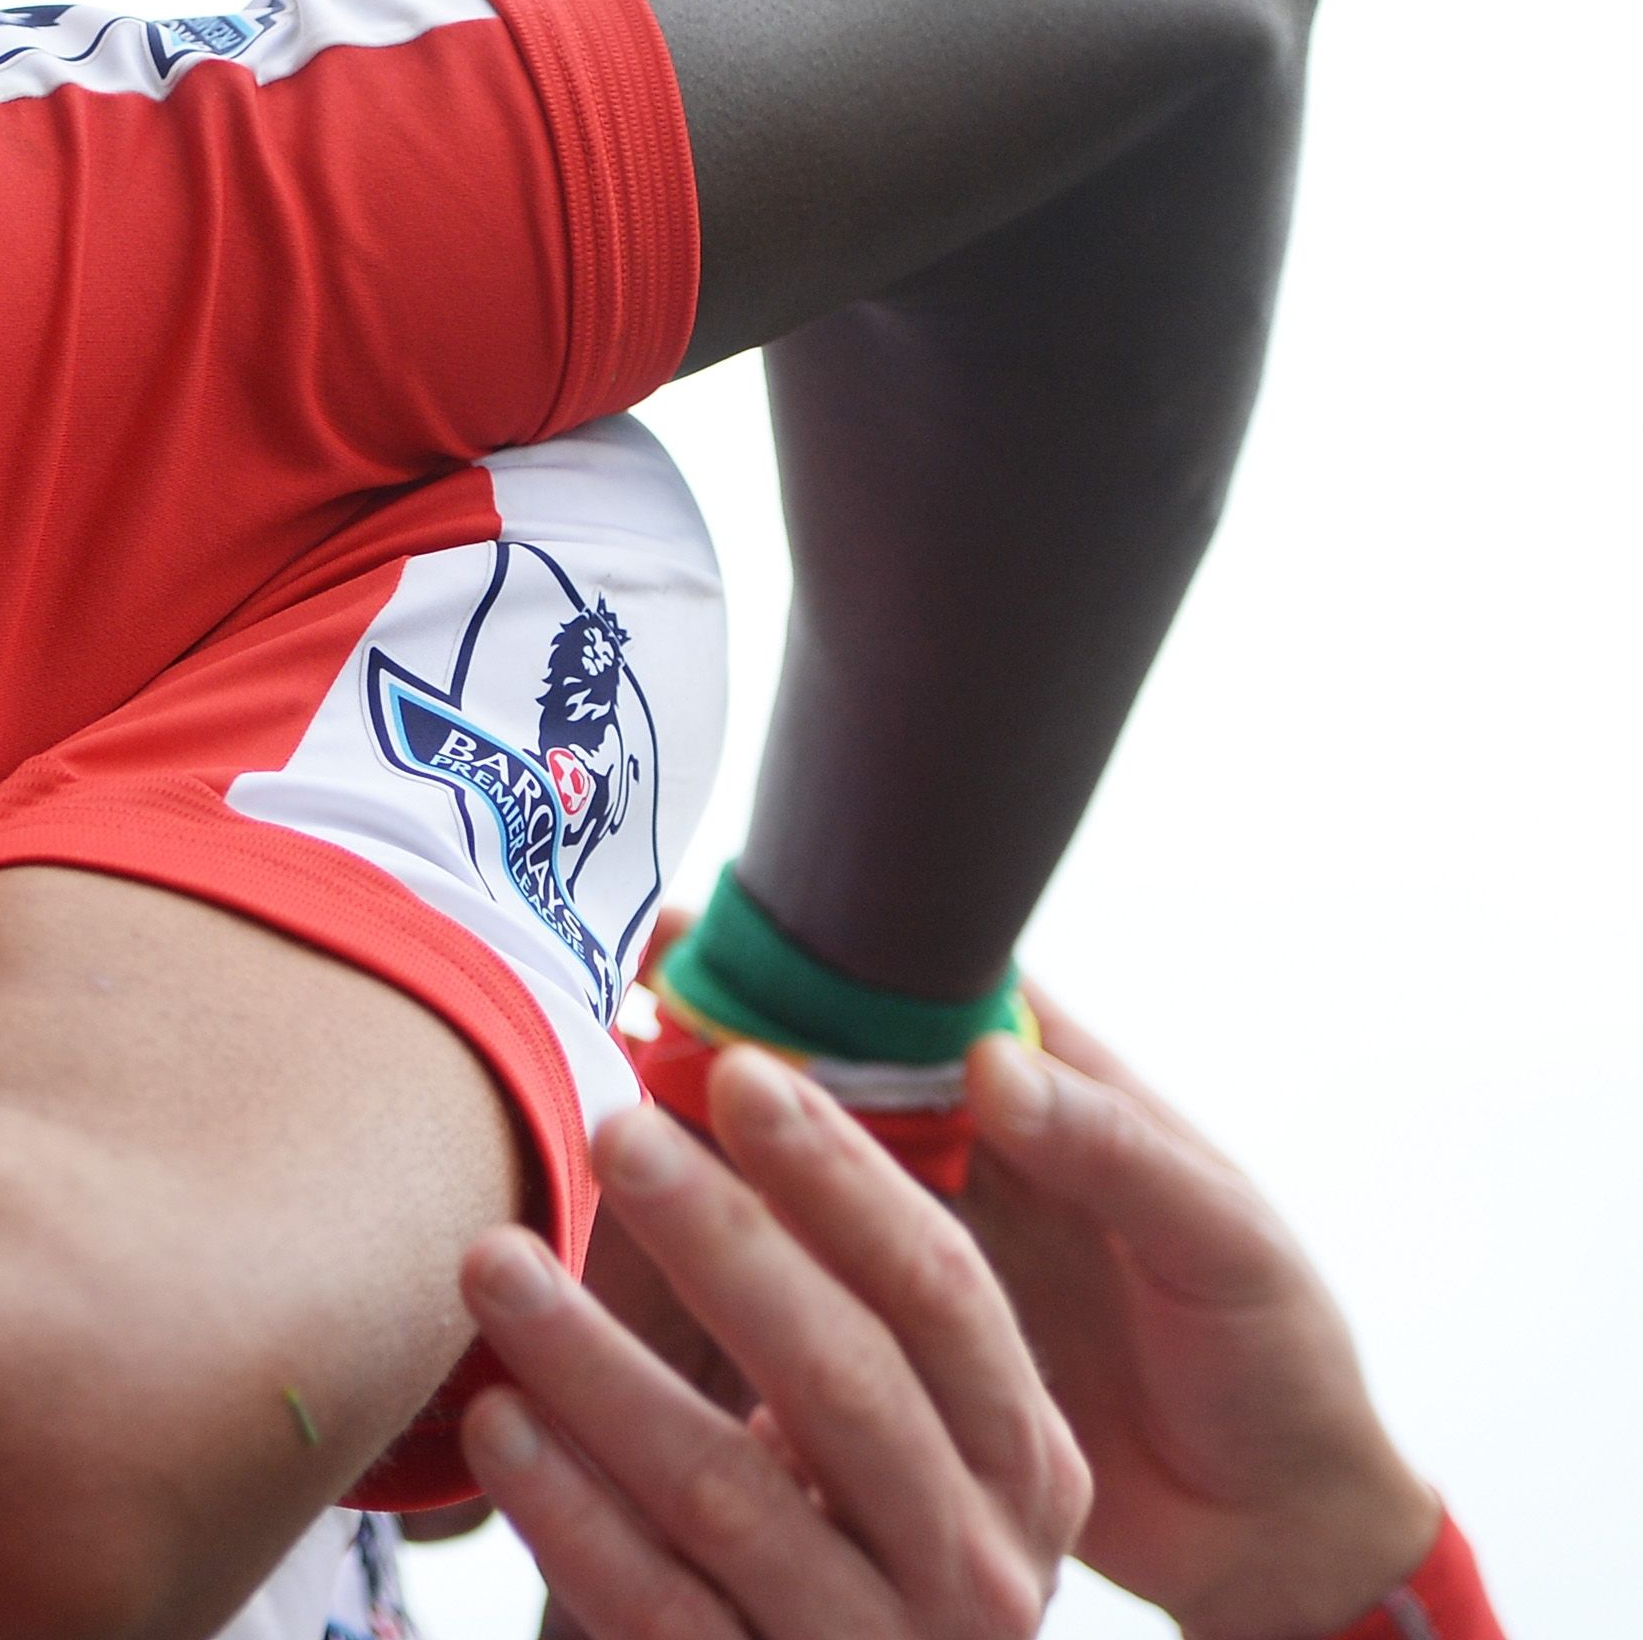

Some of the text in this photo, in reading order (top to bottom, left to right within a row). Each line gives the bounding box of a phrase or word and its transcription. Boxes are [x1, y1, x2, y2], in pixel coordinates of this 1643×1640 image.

[429, 754, 587, 960] PREMIER LEAGUE
[438, 728, 584, 942] BARCLAYS
